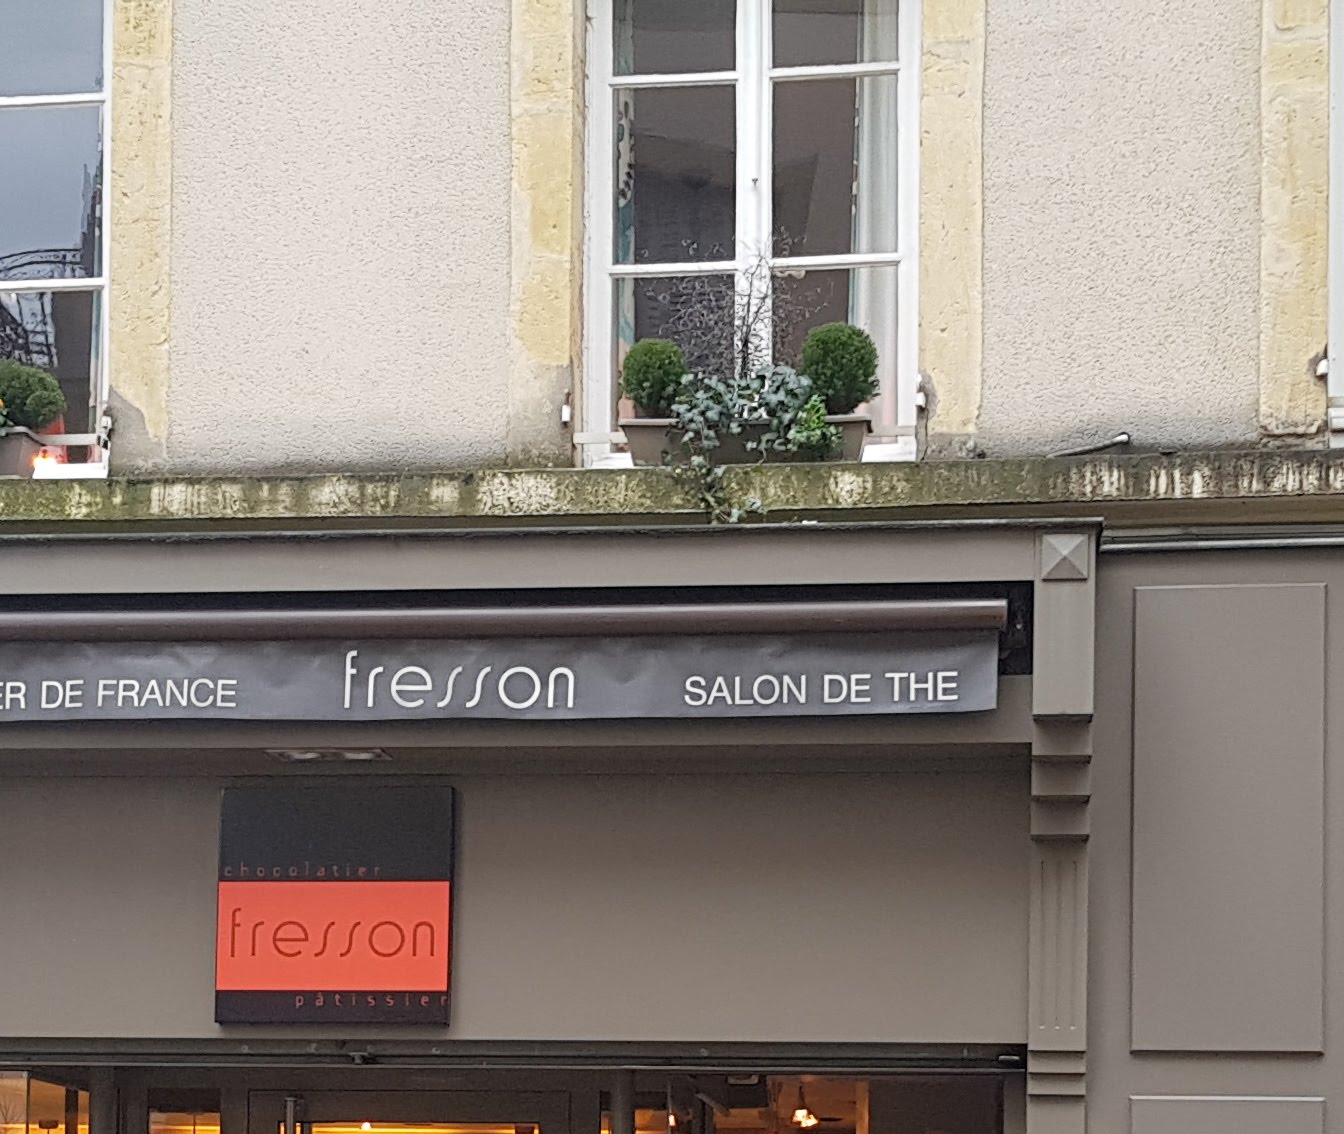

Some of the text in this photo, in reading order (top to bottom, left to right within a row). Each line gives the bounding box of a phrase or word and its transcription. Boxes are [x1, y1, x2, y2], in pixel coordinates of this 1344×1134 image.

[40, 680, 84, 709] DE
[97, 678, 238, 708] FRANCE
[343, 650, 575, 709] fresson
[683, 671, 959, 707] SALON DE THE
[224, 861, 380, 877] chocolatier
[230, 907, 435, 958] fresson
[295, 992, 449, 1009] pâtissier
